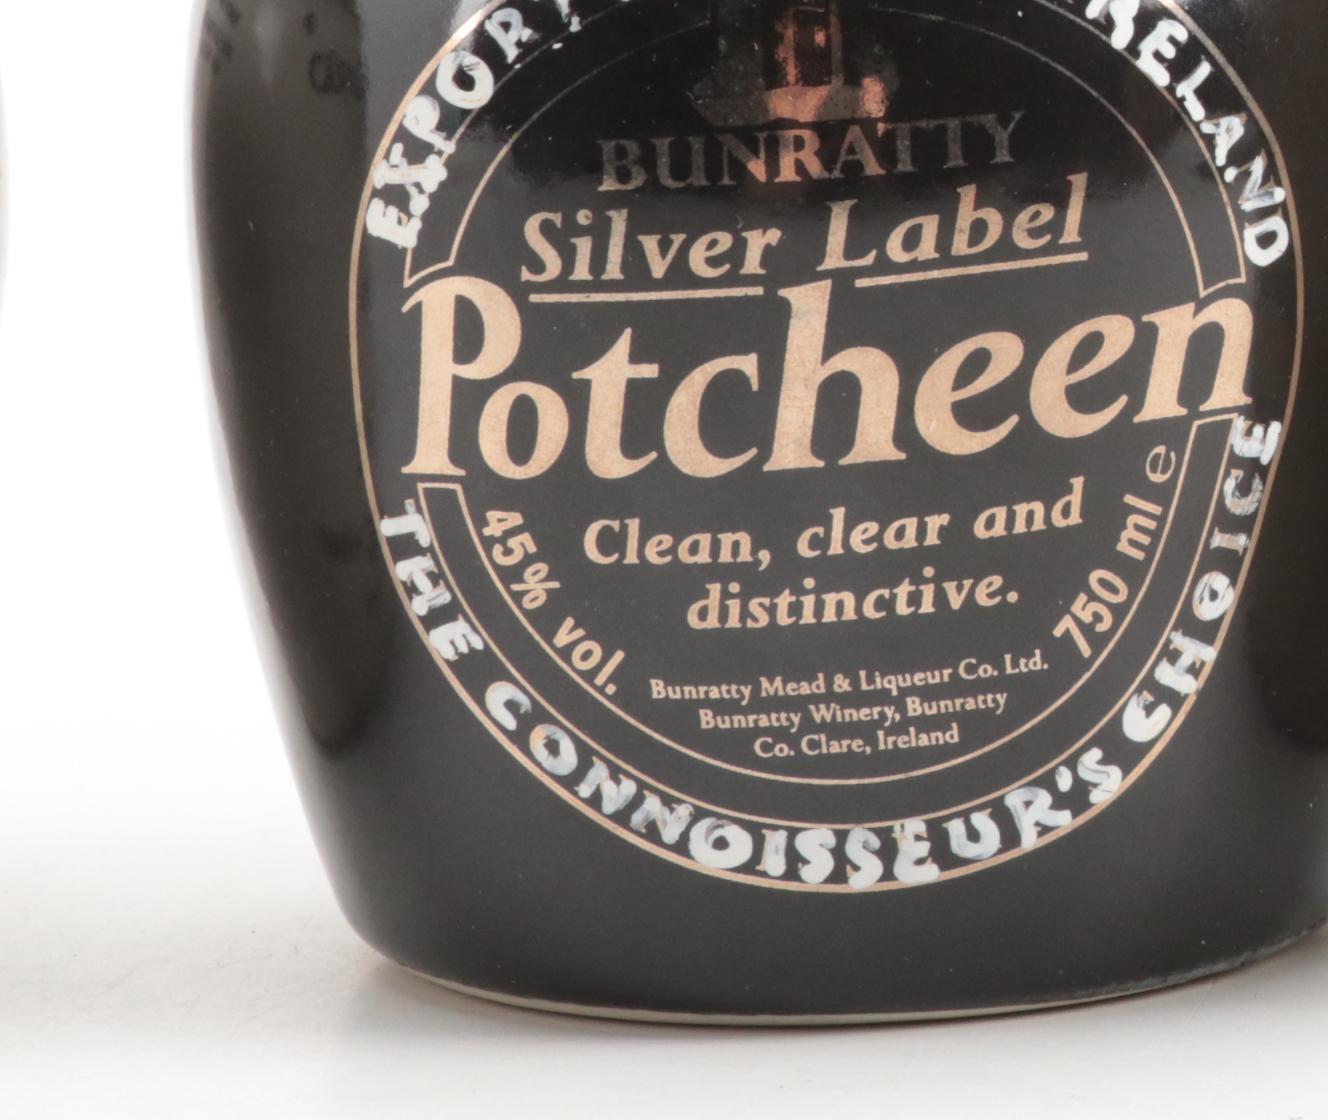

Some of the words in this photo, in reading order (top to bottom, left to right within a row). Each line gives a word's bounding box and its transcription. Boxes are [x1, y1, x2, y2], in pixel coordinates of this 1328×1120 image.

[597, 111, 1025, 193] BUNRATTY
[520, 208, 783, 283] Silver
[816, 172, 1089, 272] Label
[401, 275, 1255, 480] Potcheen
[583, 517, 772, 571] Clean,
[797, 506, 951, 560] clear
[972, 476, 1085, 541] and
[482, 509, 561, 610] 45%
[552, 616, 625, 696] vol.
[687, 566, 1020, 631] distinctive.
[1052, 568, 1129, 659] 750
[1115, 493, 1164, 562] ml
[378, 497, 485, 662] THE
[484, 681, 1124, 889] CONNOISSEUR'S
[1121, 414, 1283, 743] CHOICE
[649, 678, 752, 707] Bunratty
[759, 673, 826, 699] Mead
[832, 672, 852, 694] &
[859, 666, 953, 698] Liqueur
[959, 656, 999, 680] Co.
[1004, 649, 1050, 676] Ltd.
[698, 708, 802, 733] Bunratty
[807, 701, 900, 728] Winery,
[906, 690, 1008, 720] Bunratty
[753, 736, 795, 760] Co.
[800, 732, 872, 757] Clare,
[877, 722, 961, 753] Ireland
